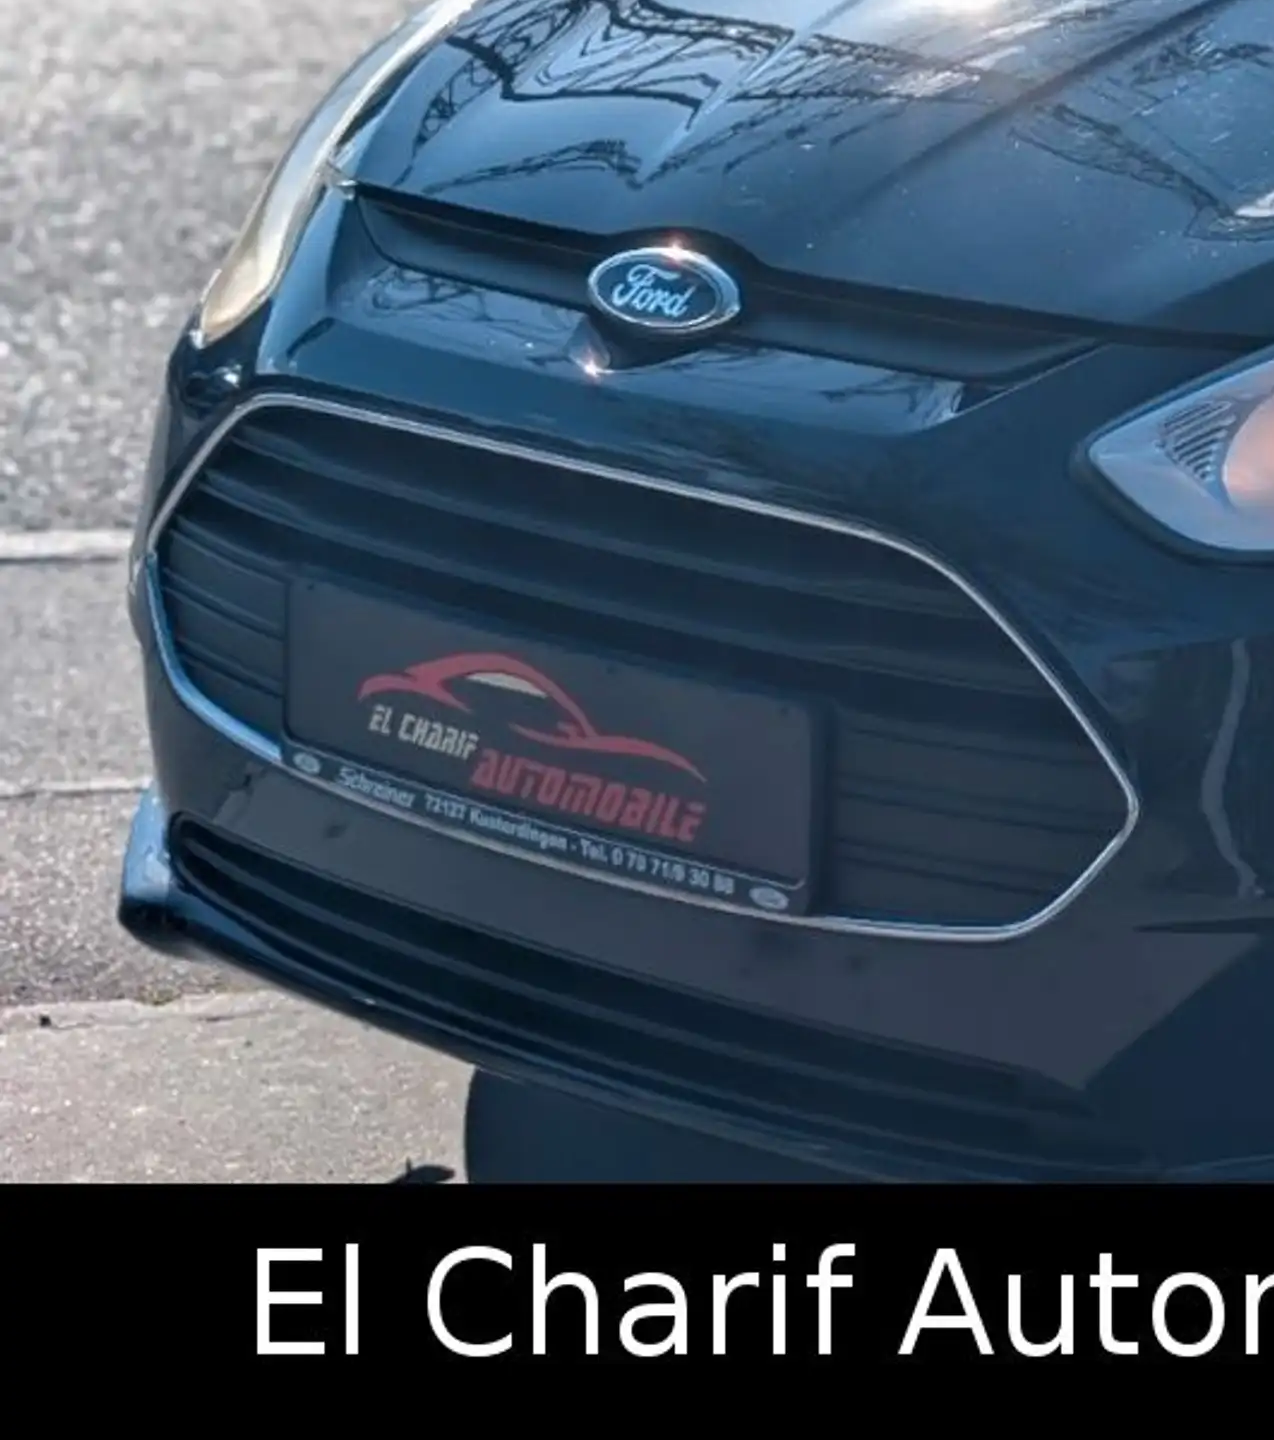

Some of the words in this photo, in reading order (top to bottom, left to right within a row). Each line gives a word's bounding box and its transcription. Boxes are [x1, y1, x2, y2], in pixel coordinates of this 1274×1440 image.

[611, 263, 697, 318] Ford
[368, 703, 394, 736] EL
[398, 712, 480, 760] CHARIF
[469, 746, 708, 843] AUTOMOBILE
[469, 806, 567, 849] Kusterdingen
